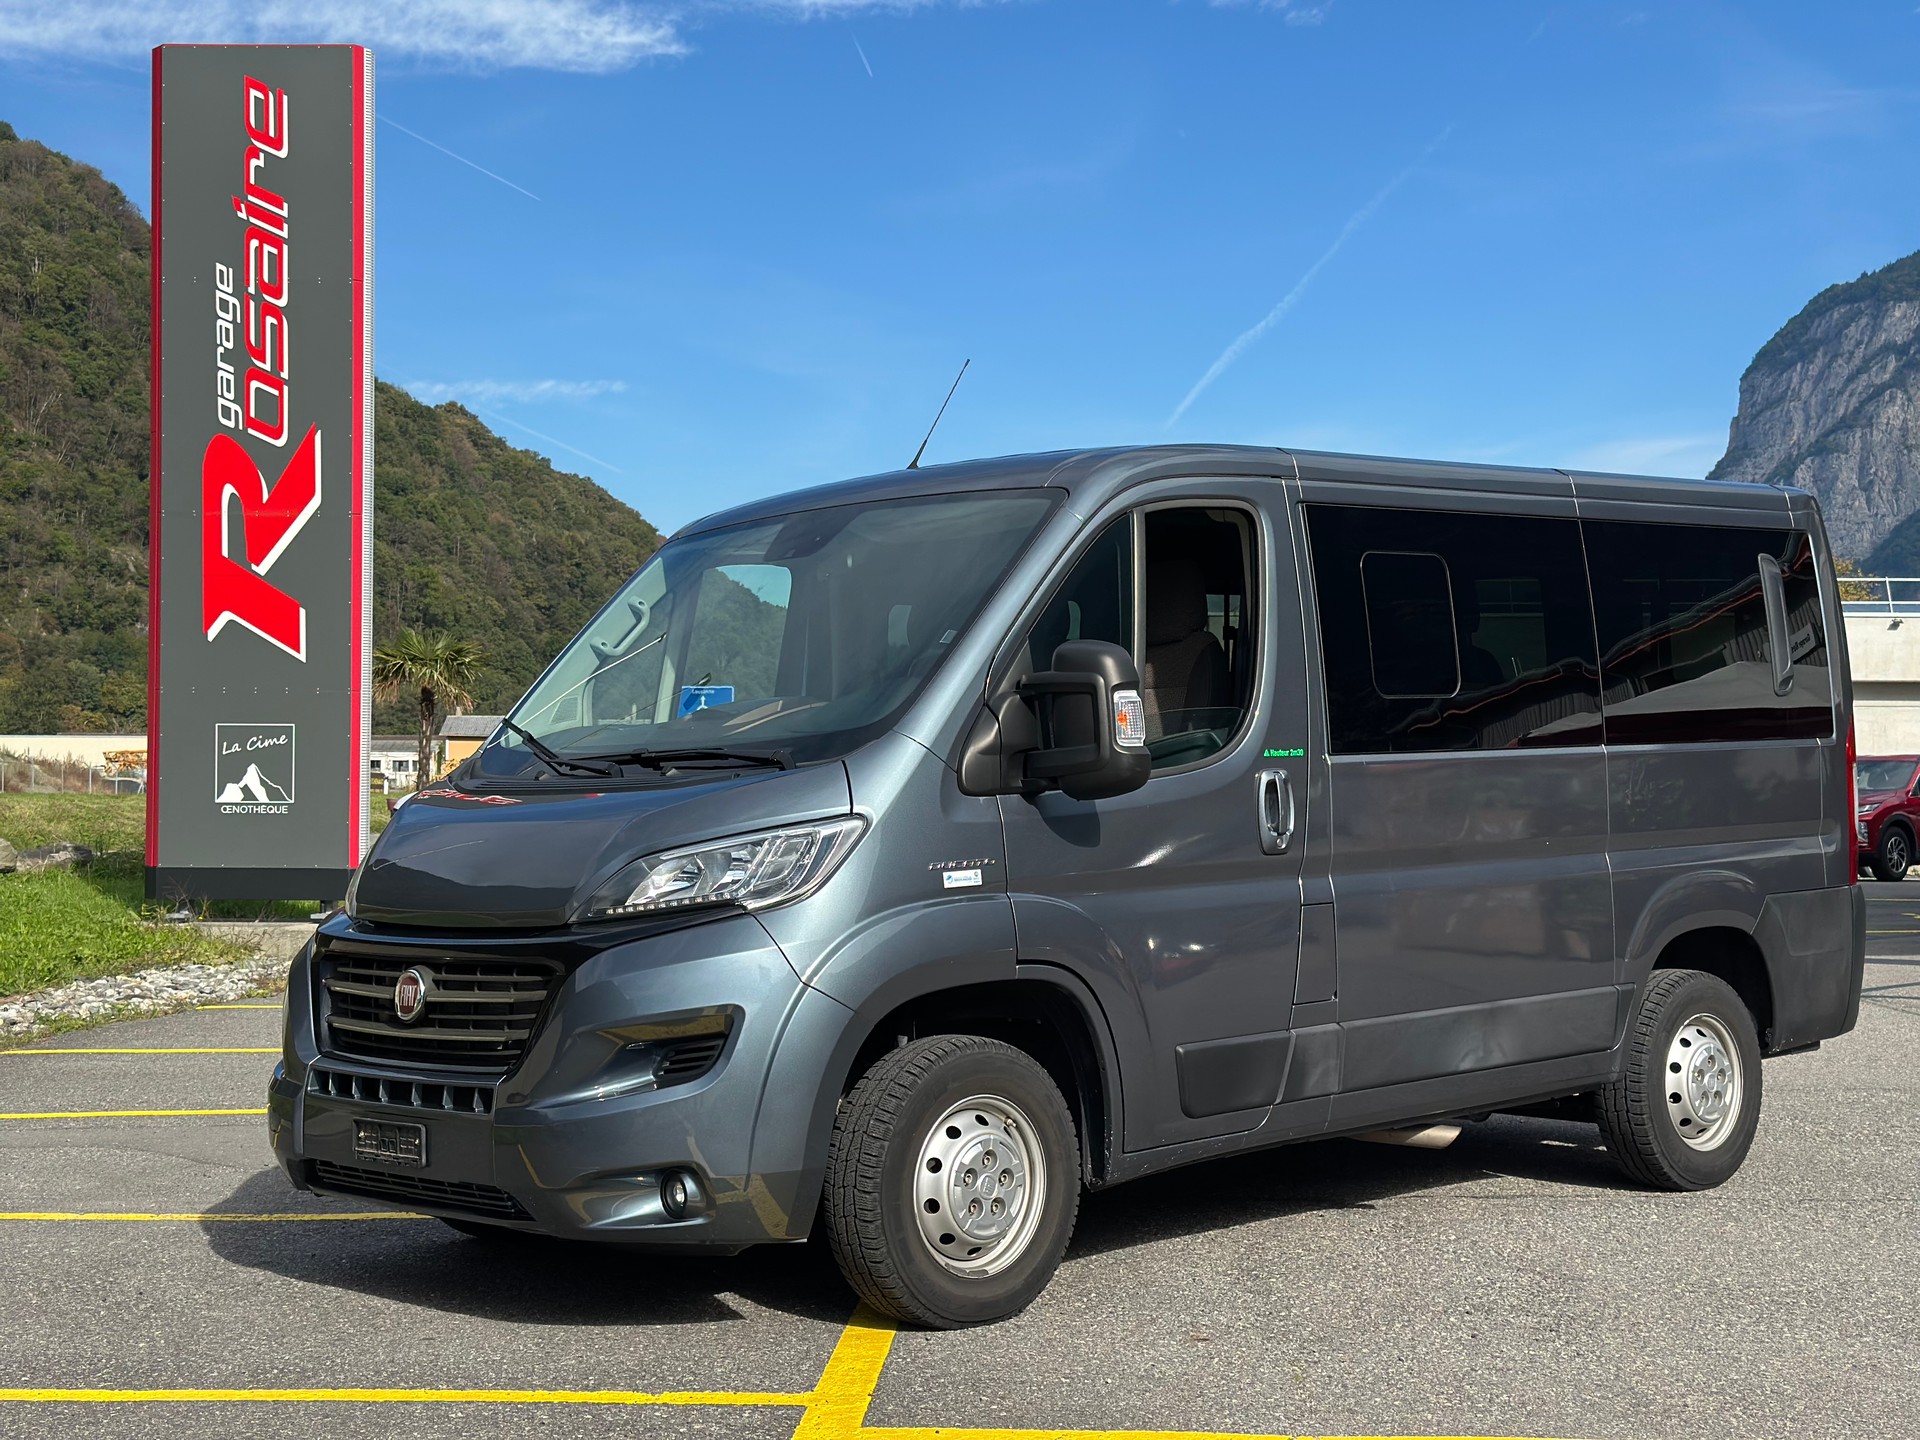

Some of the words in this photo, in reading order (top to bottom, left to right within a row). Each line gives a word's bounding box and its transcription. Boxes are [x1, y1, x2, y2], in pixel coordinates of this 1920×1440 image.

[202, 75, 322, 663] Rosaire
[215, 263, 243, 430] garage
[222, 741, 242, 755] La
[246, 734, 289, 751] Cime
[400, 985, 417, 1006] FIAT
